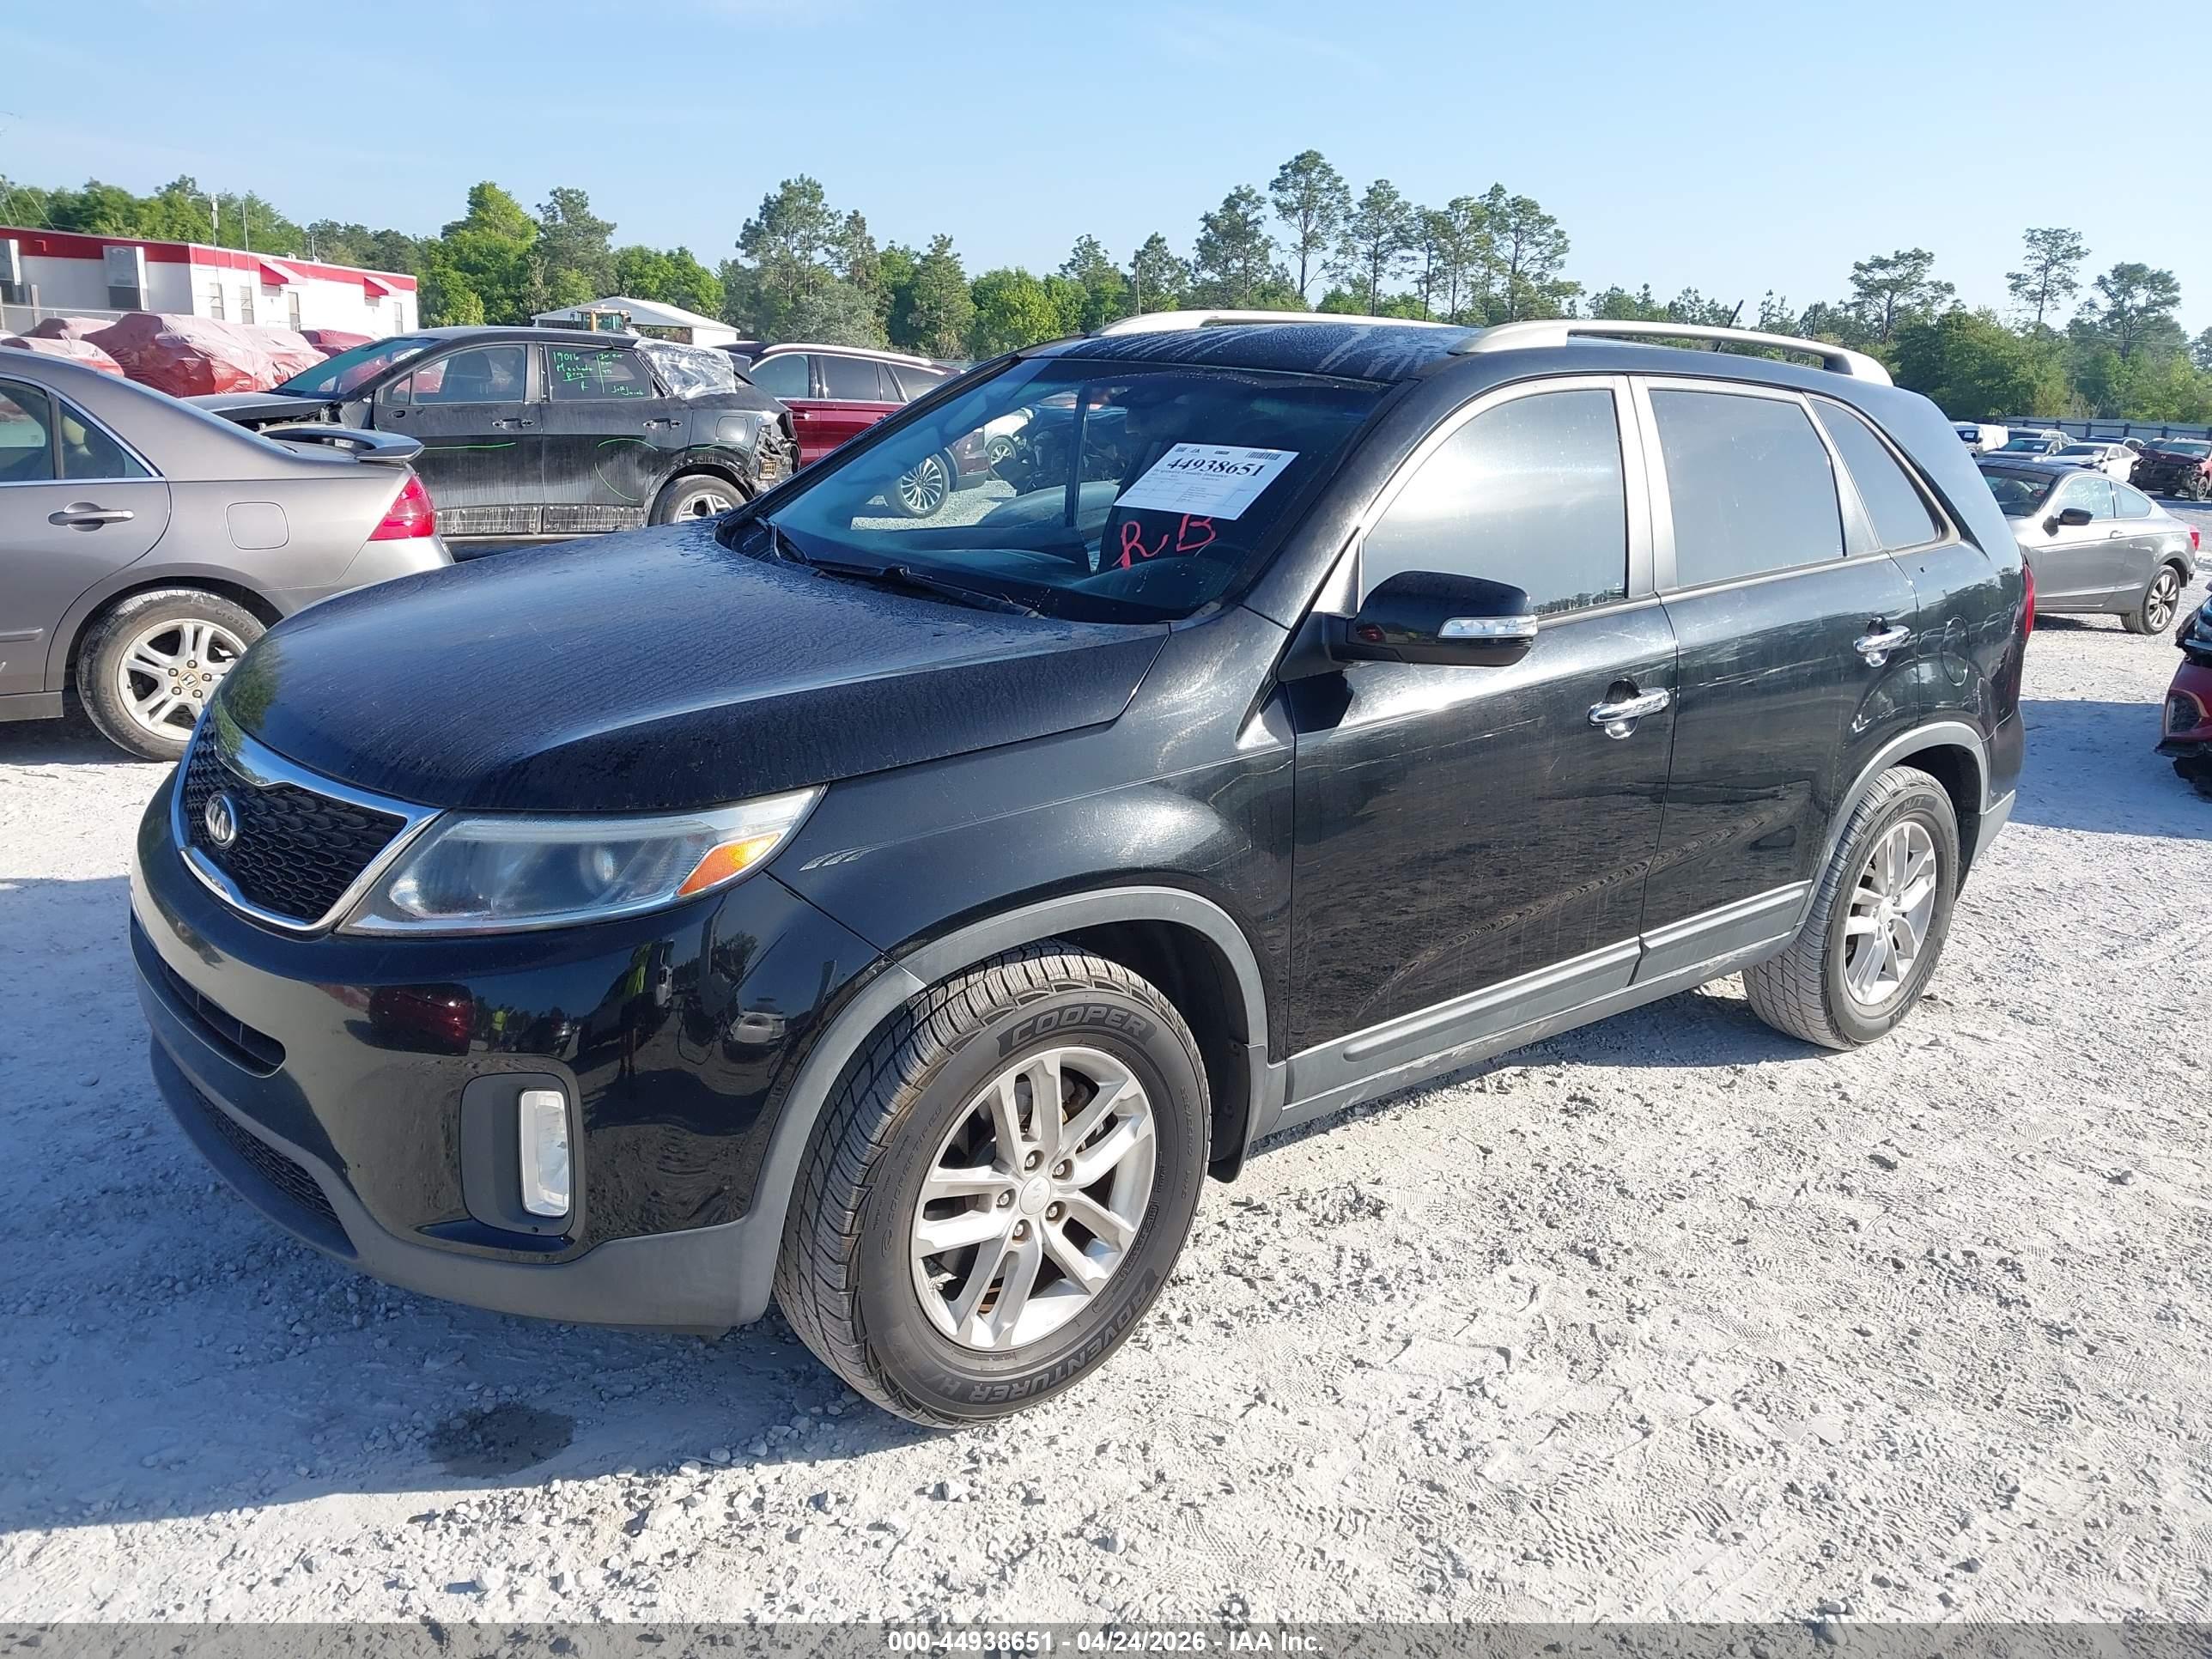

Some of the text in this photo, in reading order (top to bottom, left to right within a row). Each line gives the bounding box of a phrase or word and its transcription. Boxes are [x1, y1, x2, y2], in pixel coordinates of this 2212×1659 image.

[1166, 457, 1266, 477] 44938651
[1012, 1006, 1147, 1047] COOPER
[968, 1279, 1152, 1402] ADVENTURER
